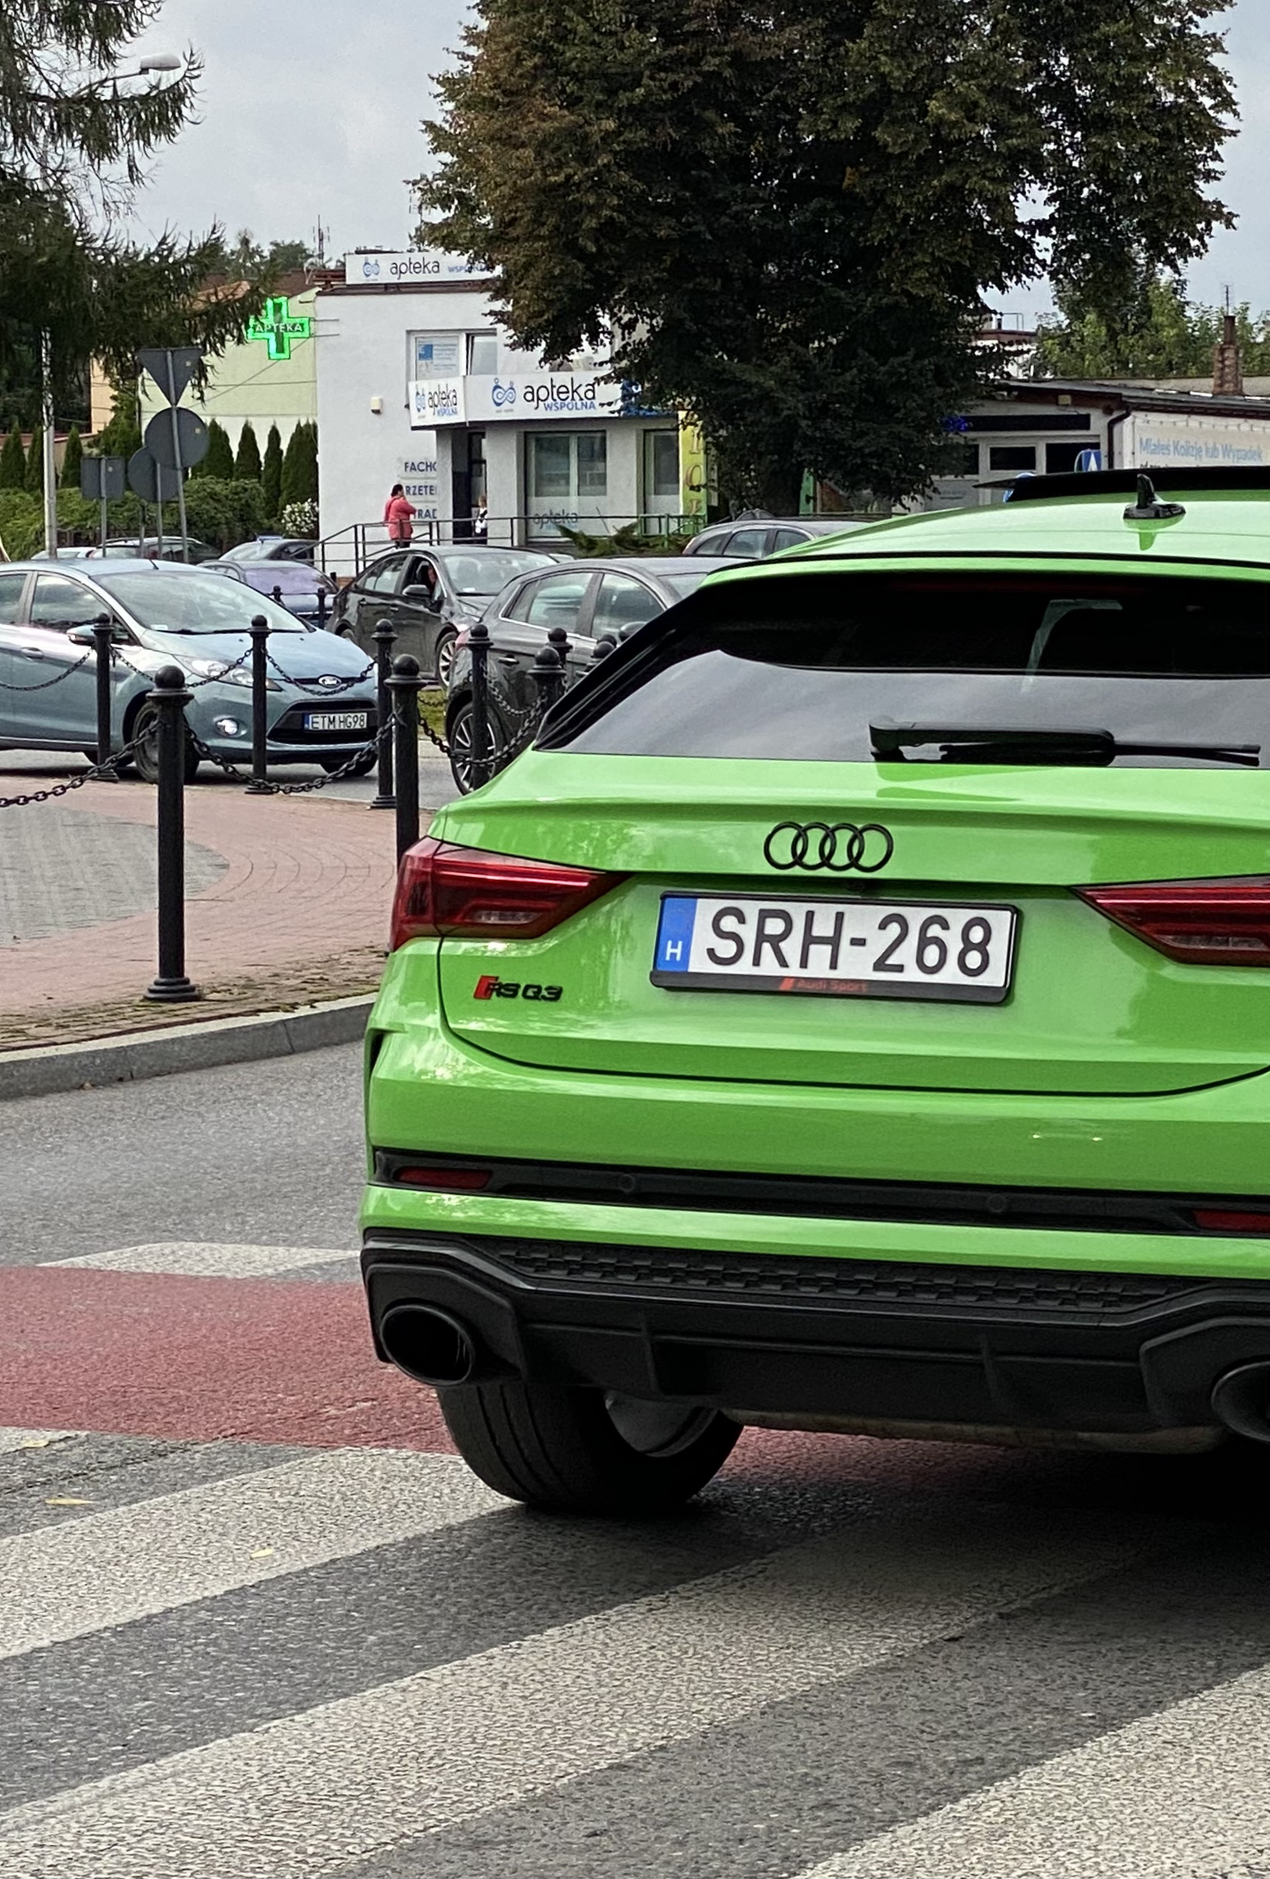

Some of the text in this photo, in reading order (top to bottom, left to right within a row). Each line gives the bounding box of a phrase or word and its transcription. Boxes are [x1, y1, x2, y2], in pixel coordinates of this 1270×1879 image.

[390, 257, 440, 279] apteka
[255, 323, 303, 333] APTEKA
[427, 383, 458, 416] apteka
[523, 377, 596, 410] apteka
[543, 400, 596, 412] WSPÓLNA
[405, 484, 437, 496] RZETE
[311, 714, 366, 729] ETM HG98
[665, 940, 682, 962] H
[706, 906, 992, 977] SRH-268
[478, 977, 563, 1002] RS Q3
[797, 979, 868, 993] Audi Sport
